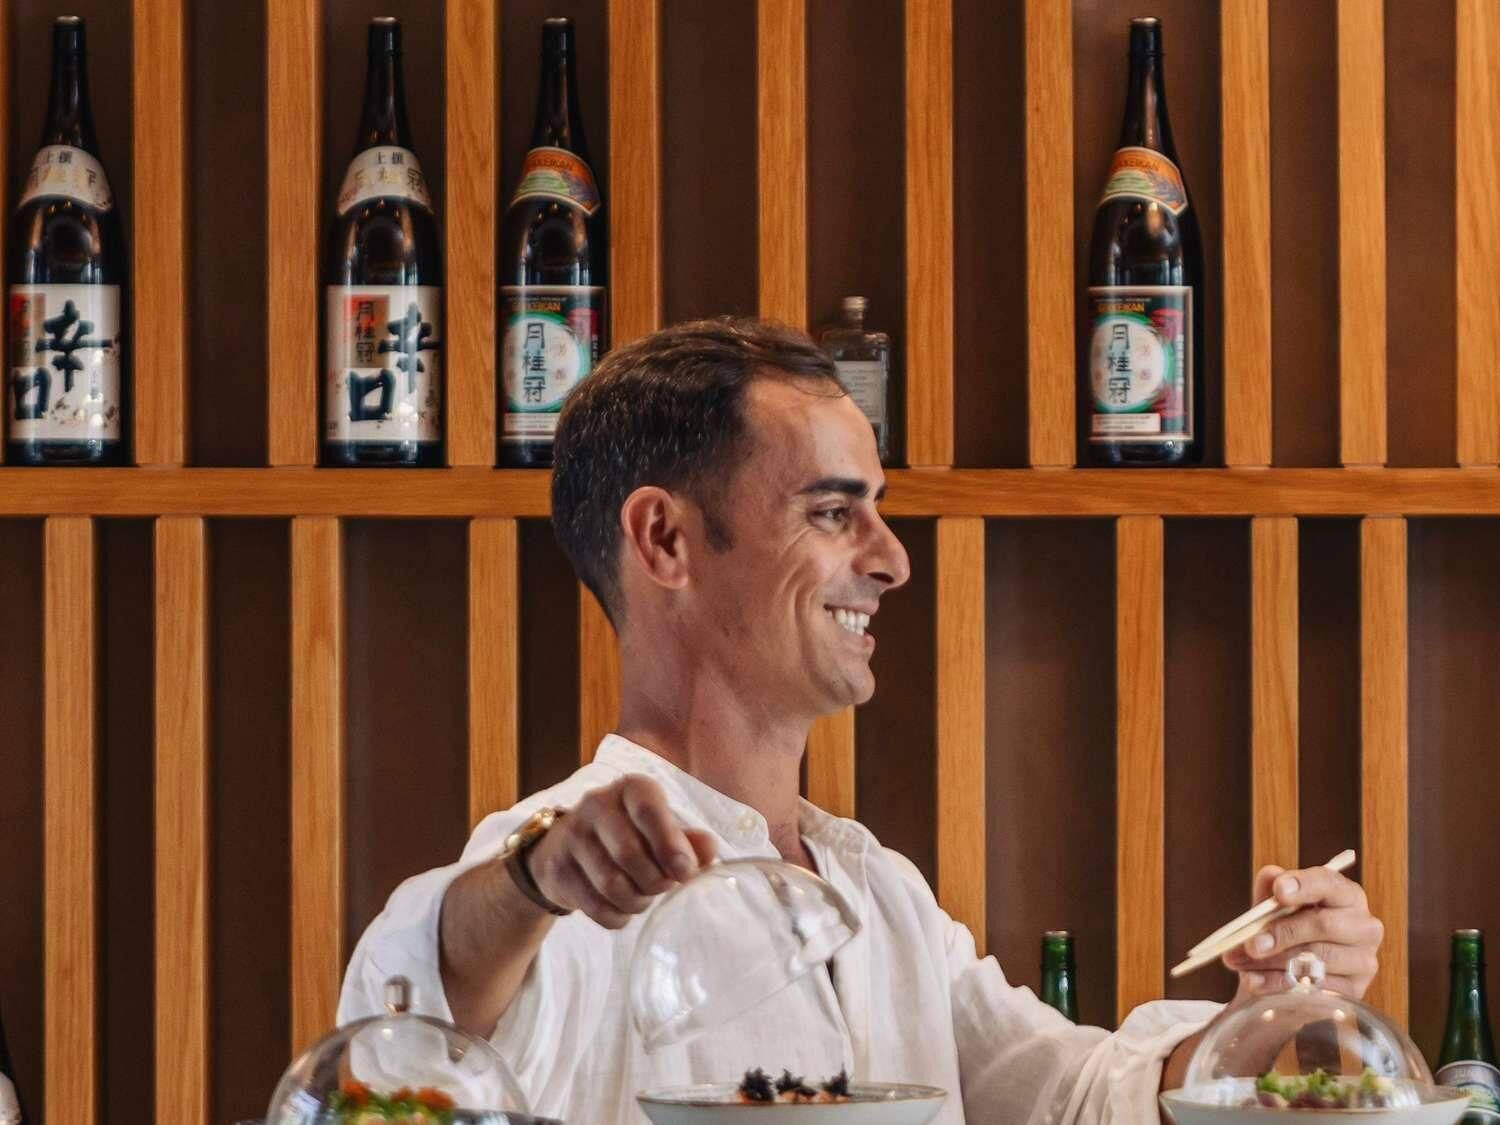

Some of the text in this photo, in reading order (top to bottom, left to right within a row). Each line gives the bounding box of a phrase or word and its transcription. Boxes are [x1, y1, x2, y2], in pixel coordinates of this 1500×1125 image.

[522, 322, 546, 403] 月桂冠
[1108, 323, 1132, 404] 月桂冠
